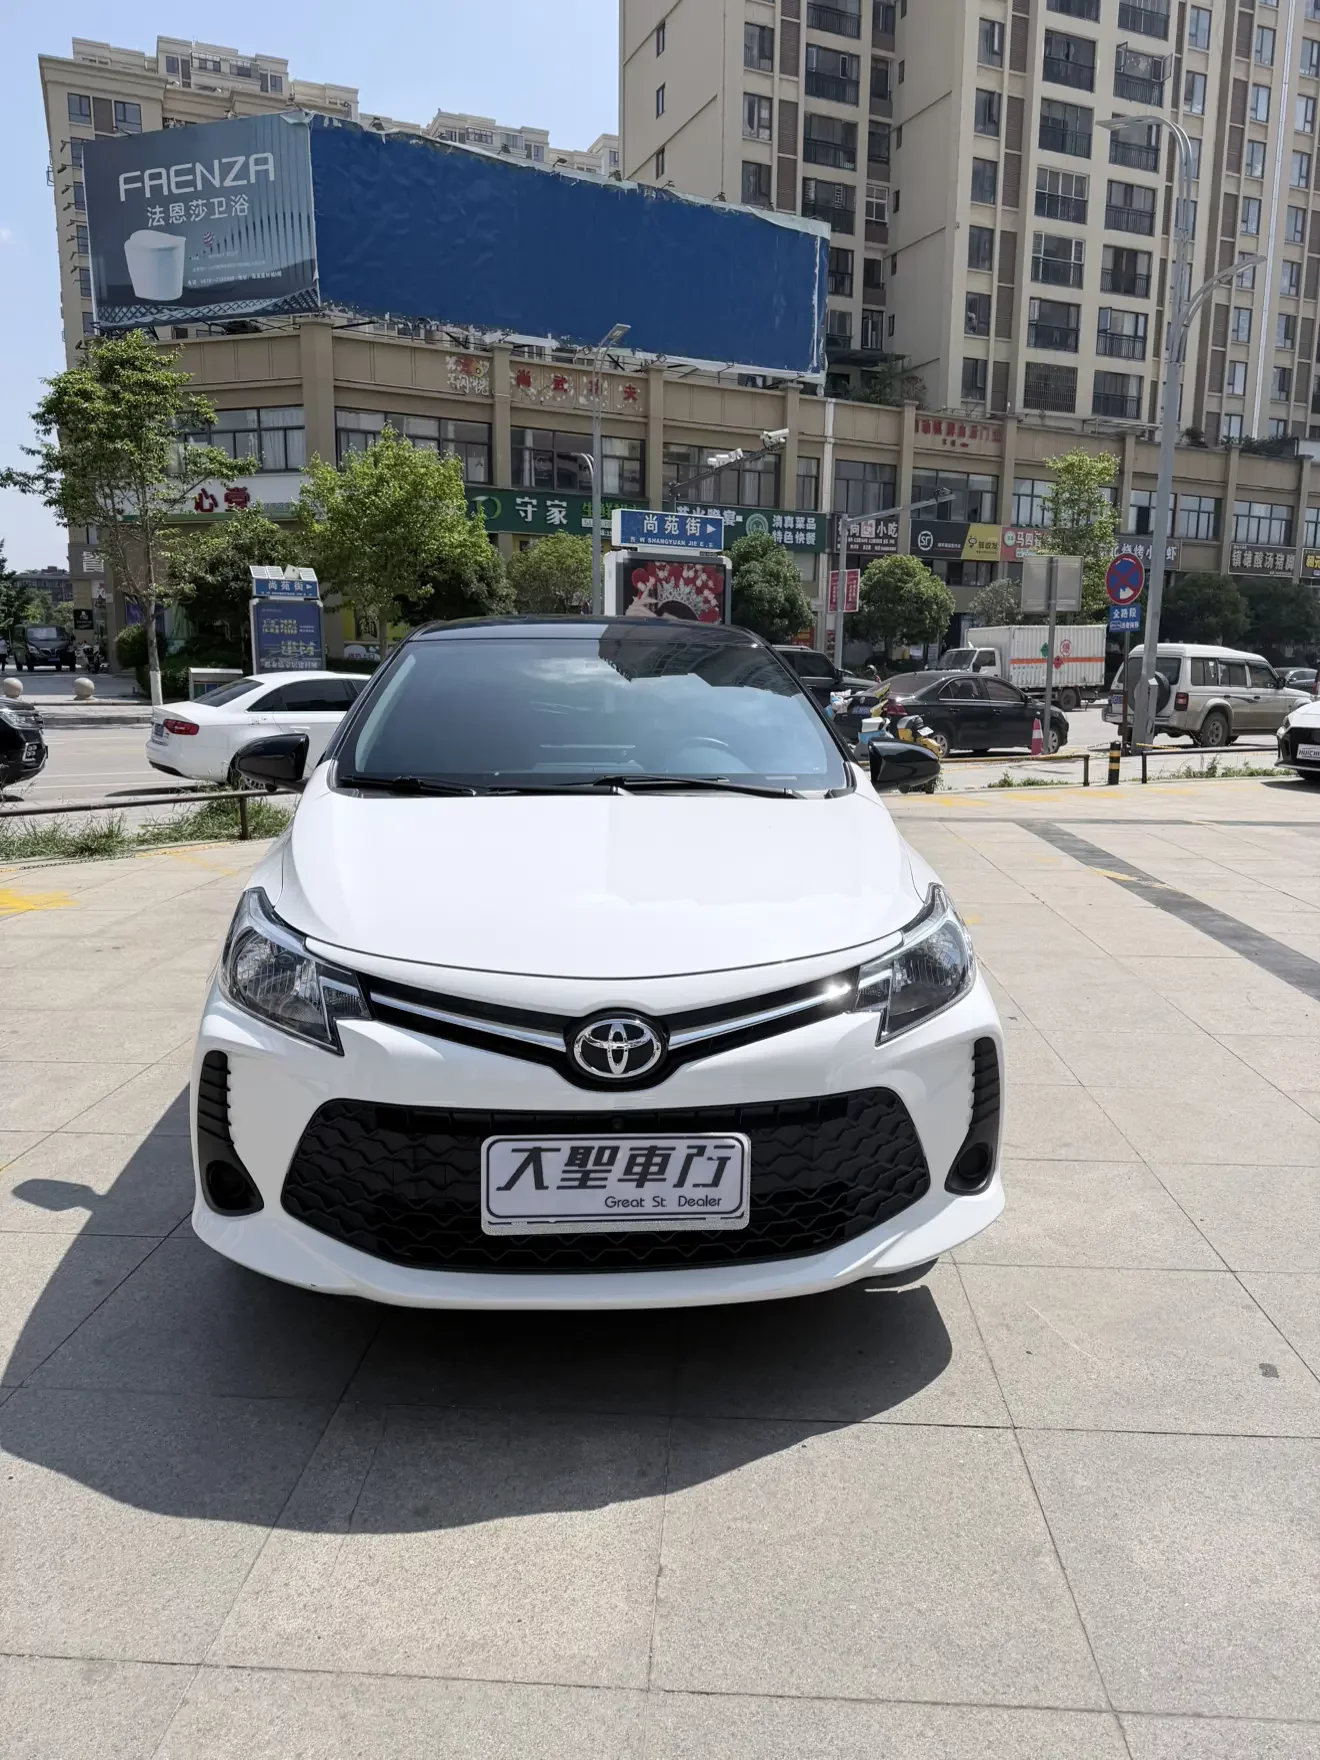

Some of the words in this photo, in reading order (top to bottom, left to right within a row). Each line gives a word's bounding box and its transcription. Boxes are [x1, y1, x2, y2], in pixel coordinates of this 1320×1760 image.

[118, 152, 275, 202] FAENZA
[147, 193, 250, 227] 法恩莎卫浴
[515, 496, 568, 525] 守家
[643, 513, 701, 536] 尚苑街
[772, 514, 816, 530] 清真菜品
[877, 520, 898, 538] 小吃
[648, 537, 686, 547] SHANGYUAN
[772, 530, 816, 546] 特色快餐
[268, 580, 304, 592] 尚苑街
[1112, 607, 1137, 619] 全路段
[496, 1144, 736, 1192] 大聖車行
[604, 1195, 645, 1209] Great
[652, 1195, 668, 1208] St.
[678, 1194, 722, 1208] Dealer
